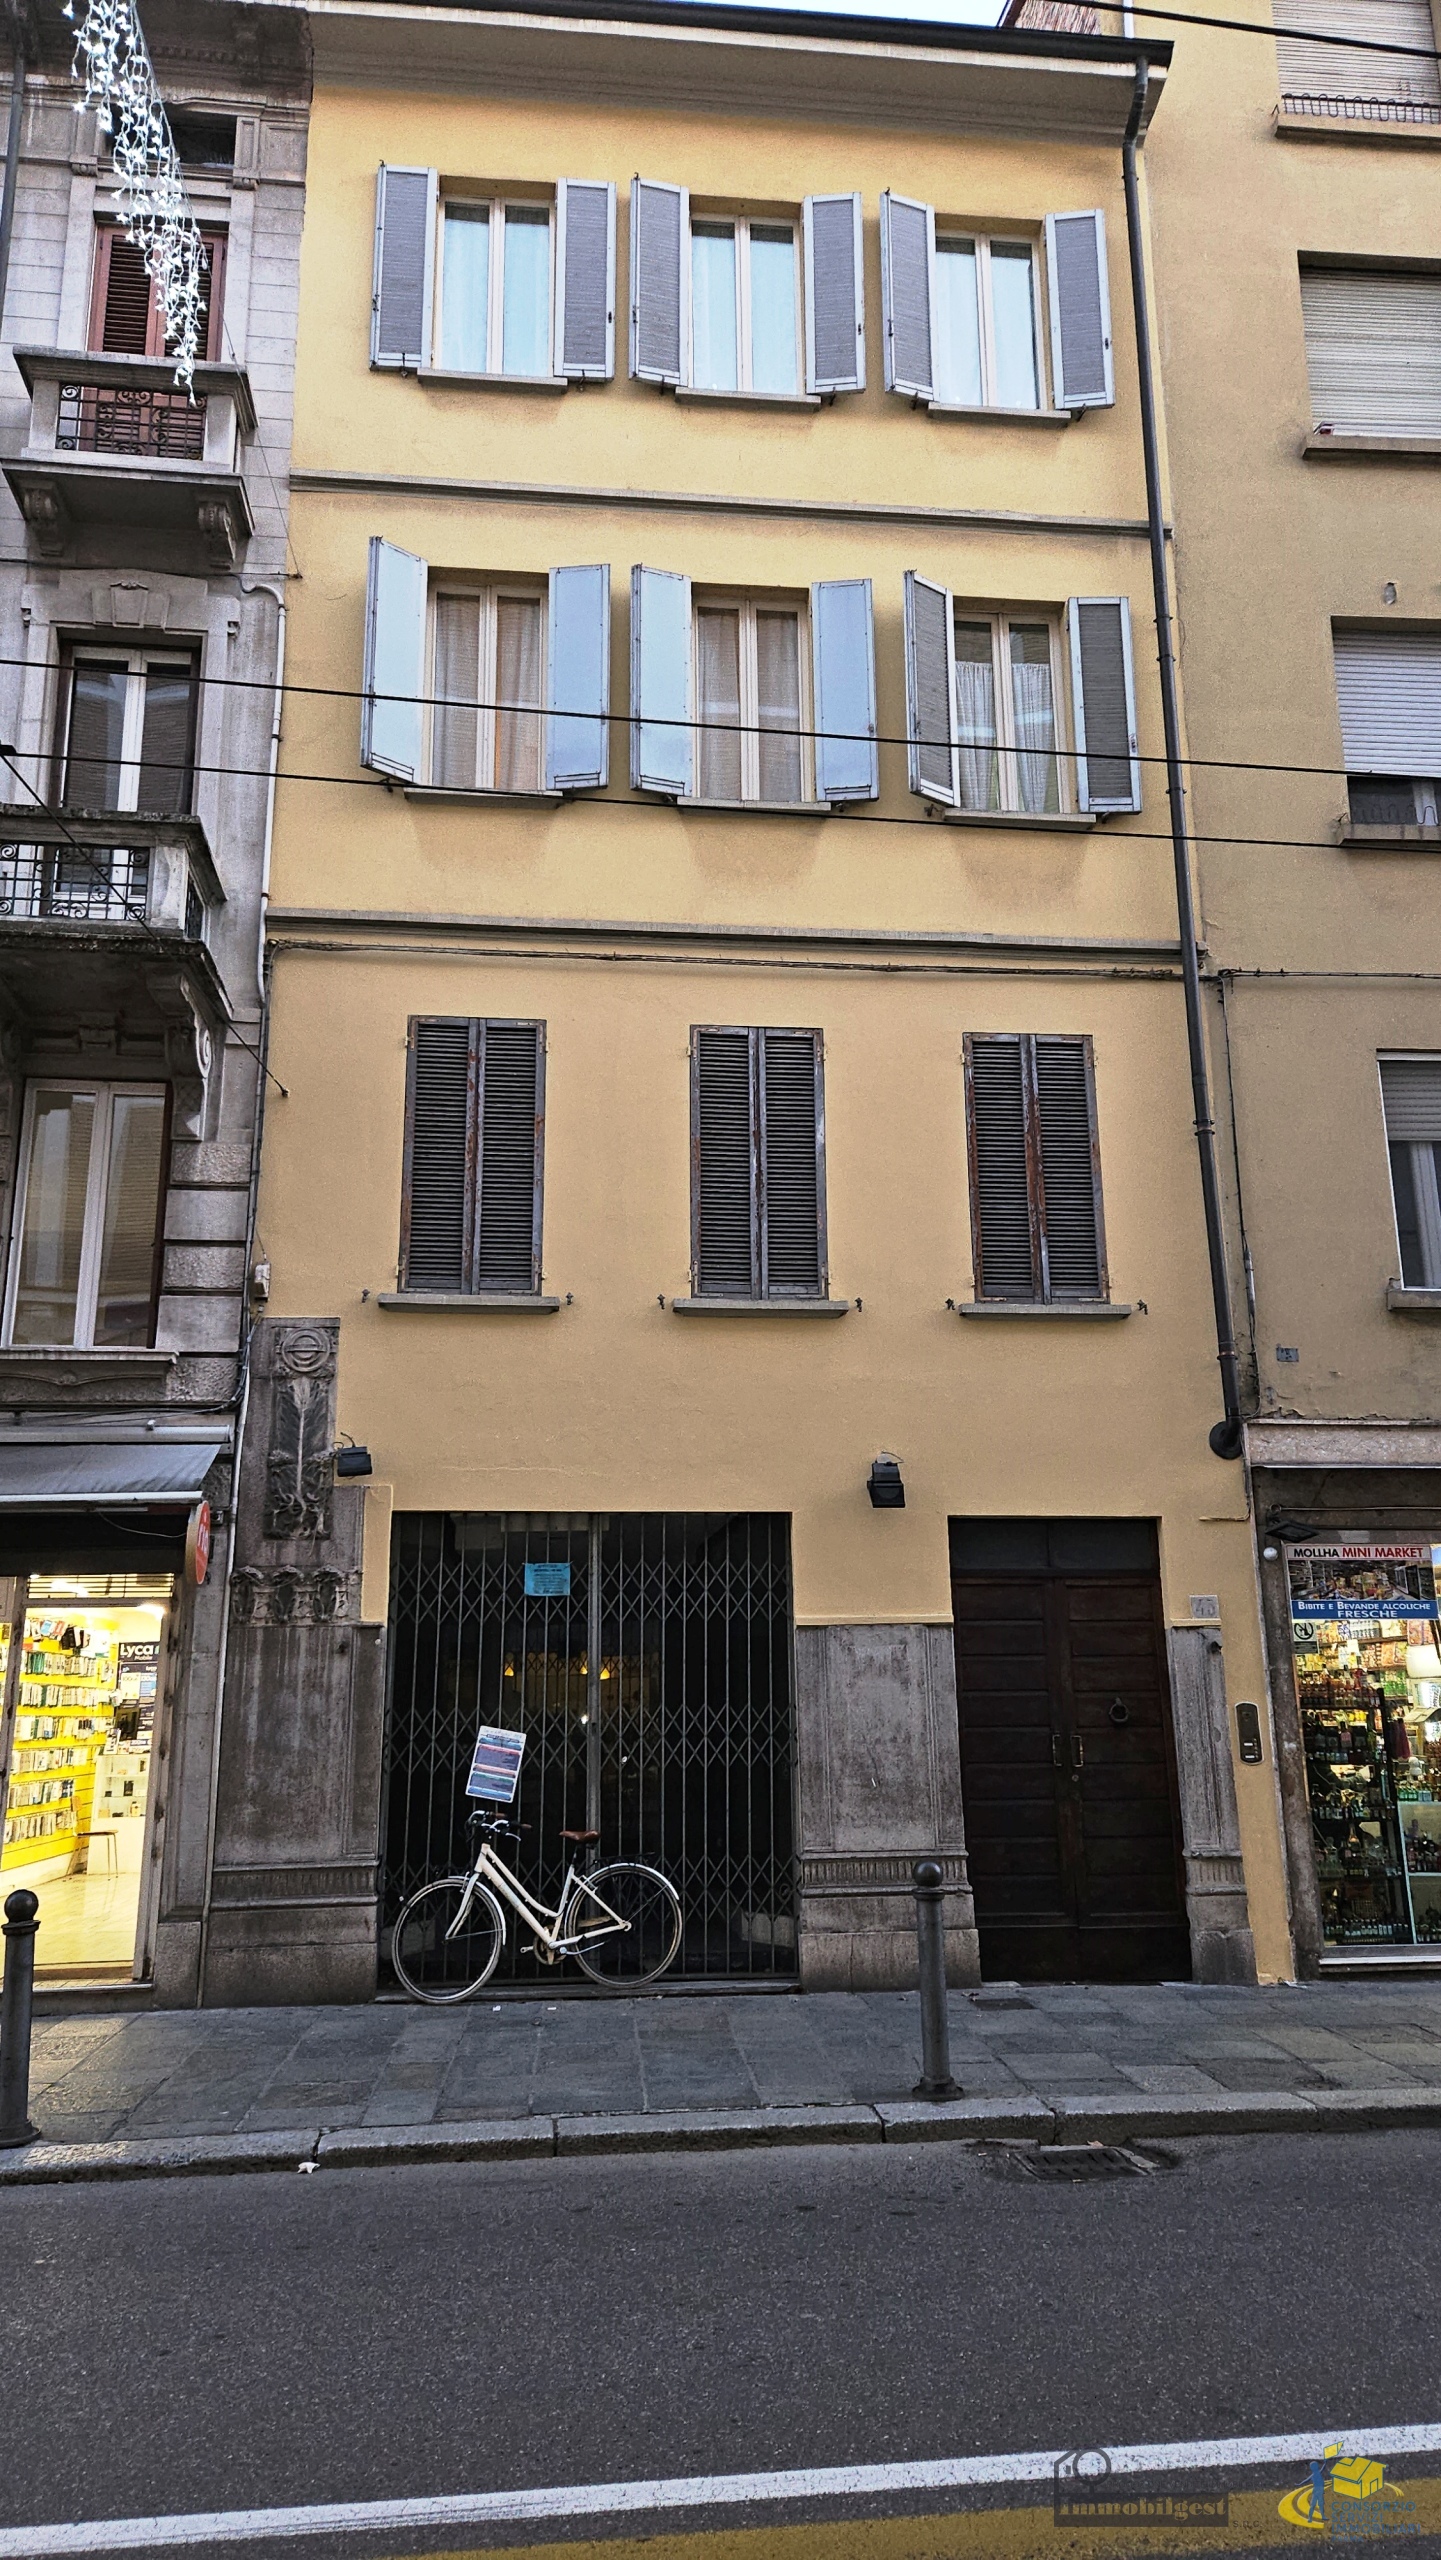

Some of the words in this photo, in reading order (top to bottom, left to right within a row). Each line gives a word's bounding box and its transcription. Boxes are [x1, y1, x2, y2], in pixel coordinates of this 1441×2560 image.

[1293, 1548, 1340, 1558] MOLLHA
[1342, 1547, 1371, 1558] MINI
[1374, 1547, 1424, 1558] MARKET
[1337, 1610, 1398, 1618] FRESCHE
[120, 1643, 154, 1658] Lyca
